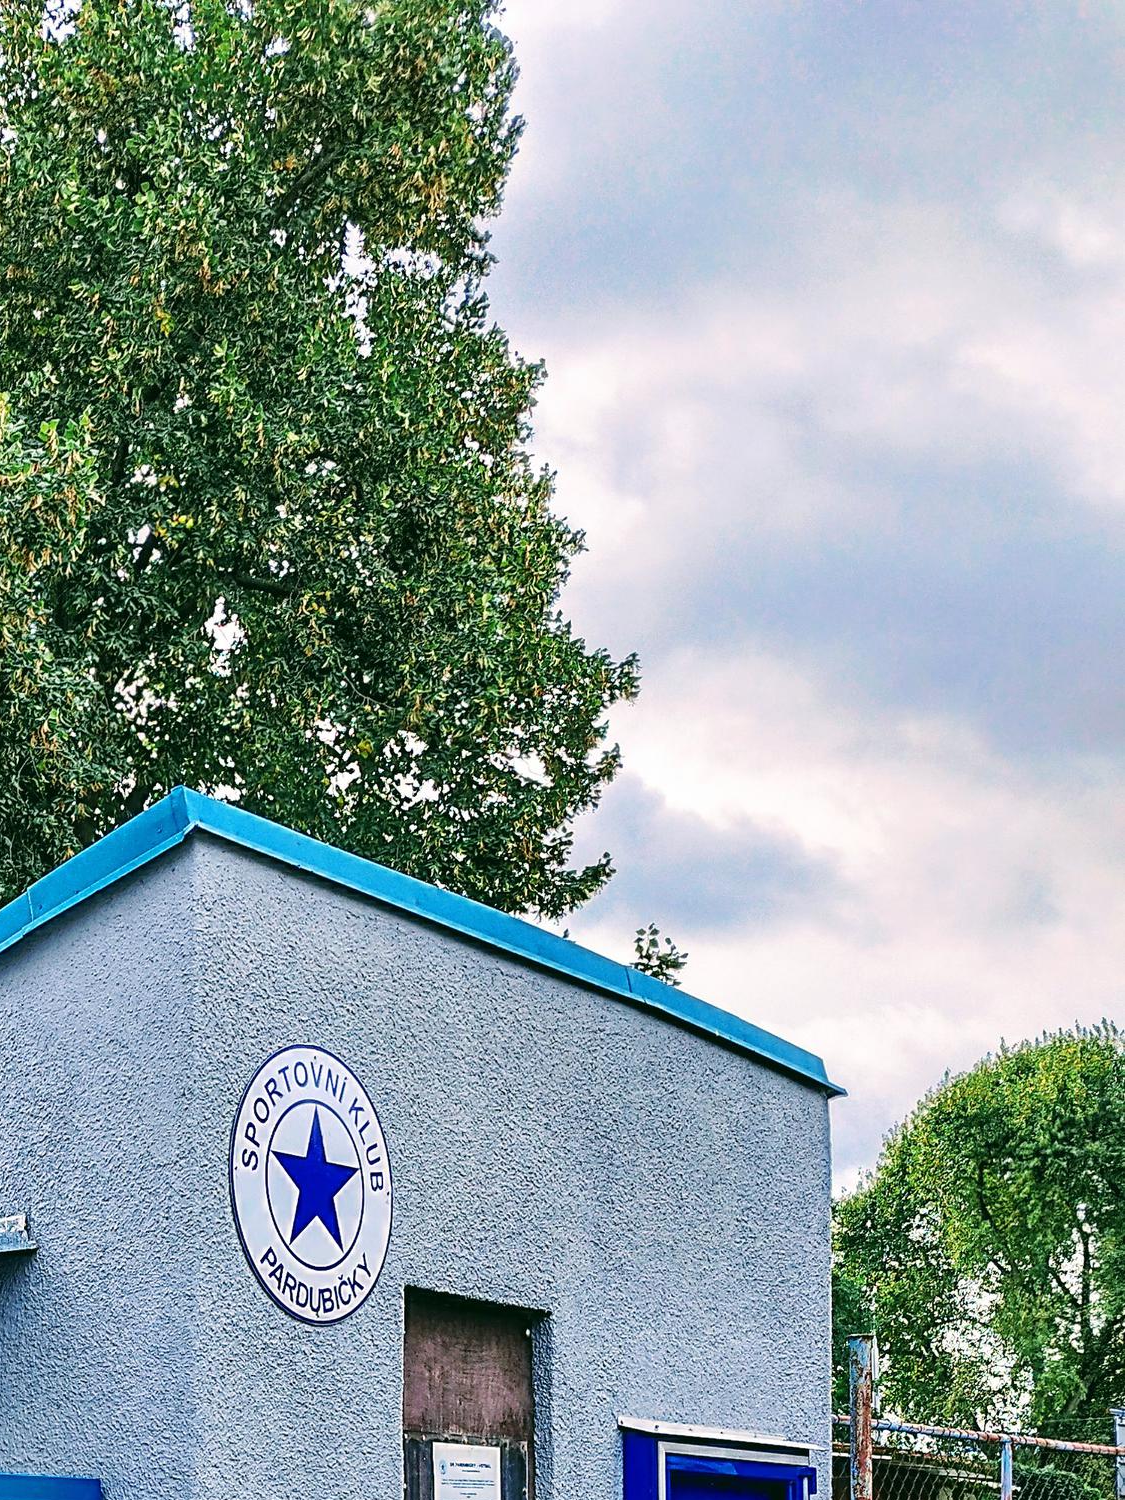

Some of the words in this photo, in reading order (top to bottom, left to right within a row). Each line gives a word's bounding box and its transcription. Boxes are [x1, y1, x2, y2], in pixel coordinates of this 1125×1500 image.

[241, 1061, 348, 1171] SPORTOVNÍ
[348, 1098, 384, 1193] KLUB
[260, 1246, 373, 1313] PARDUBIČKY
